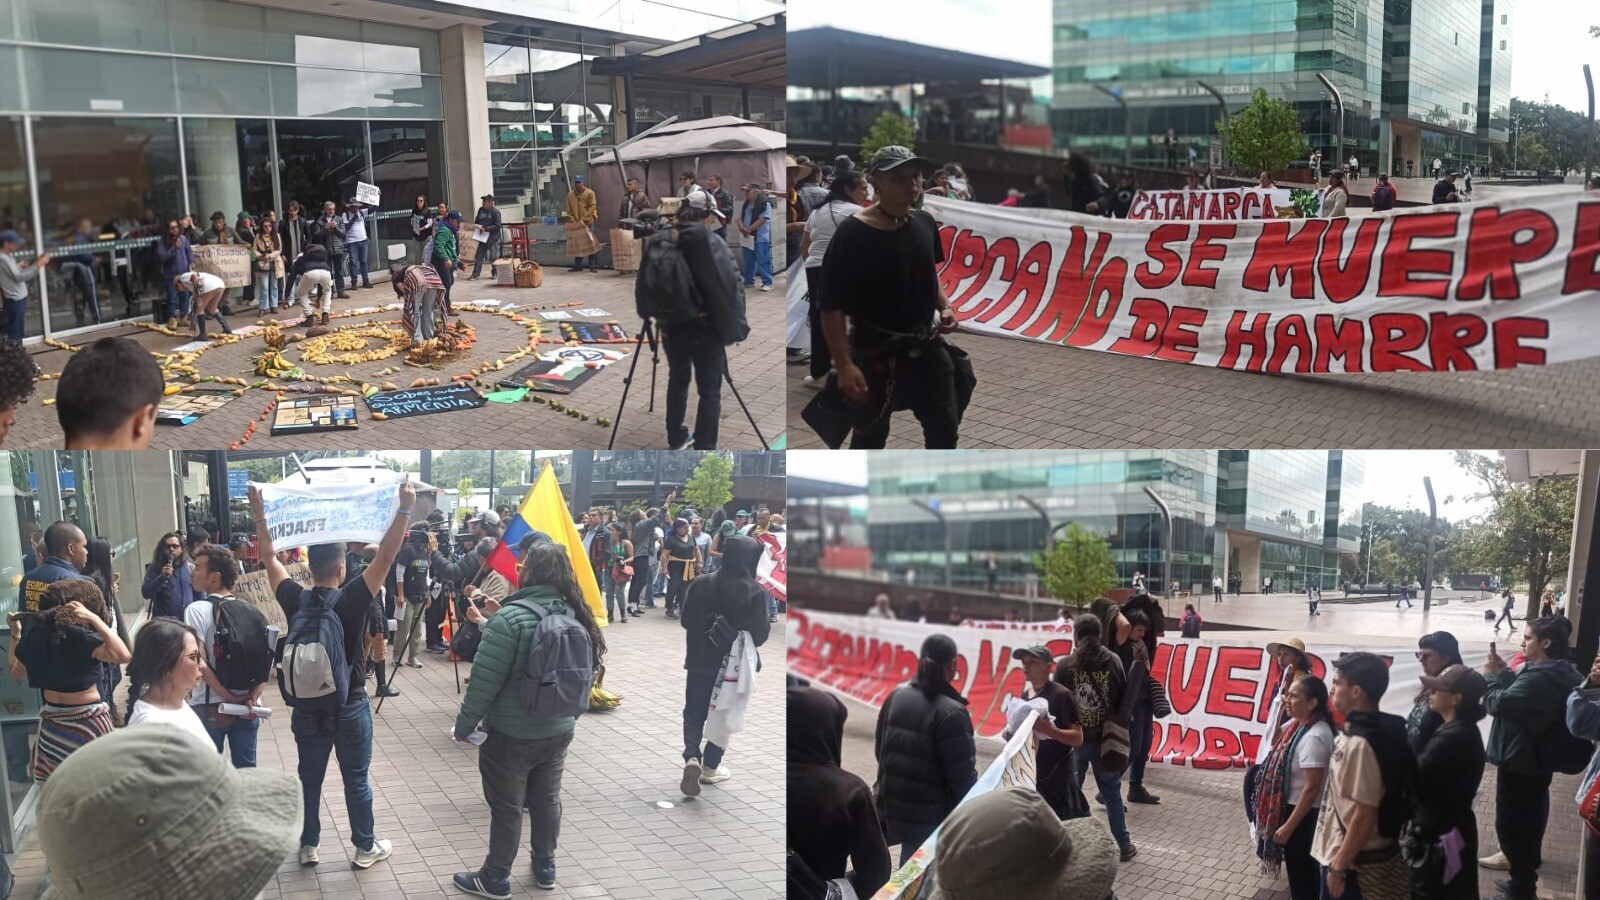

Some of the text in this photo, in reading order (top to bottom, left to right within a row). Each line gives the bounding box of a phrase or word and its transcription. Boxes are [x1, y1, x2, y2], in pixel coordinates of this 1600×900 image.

[1020, 226, 1129, 347] NO
[1134, 223, 1237, 289] SE
[1107, 298, 1207, 363] DE
